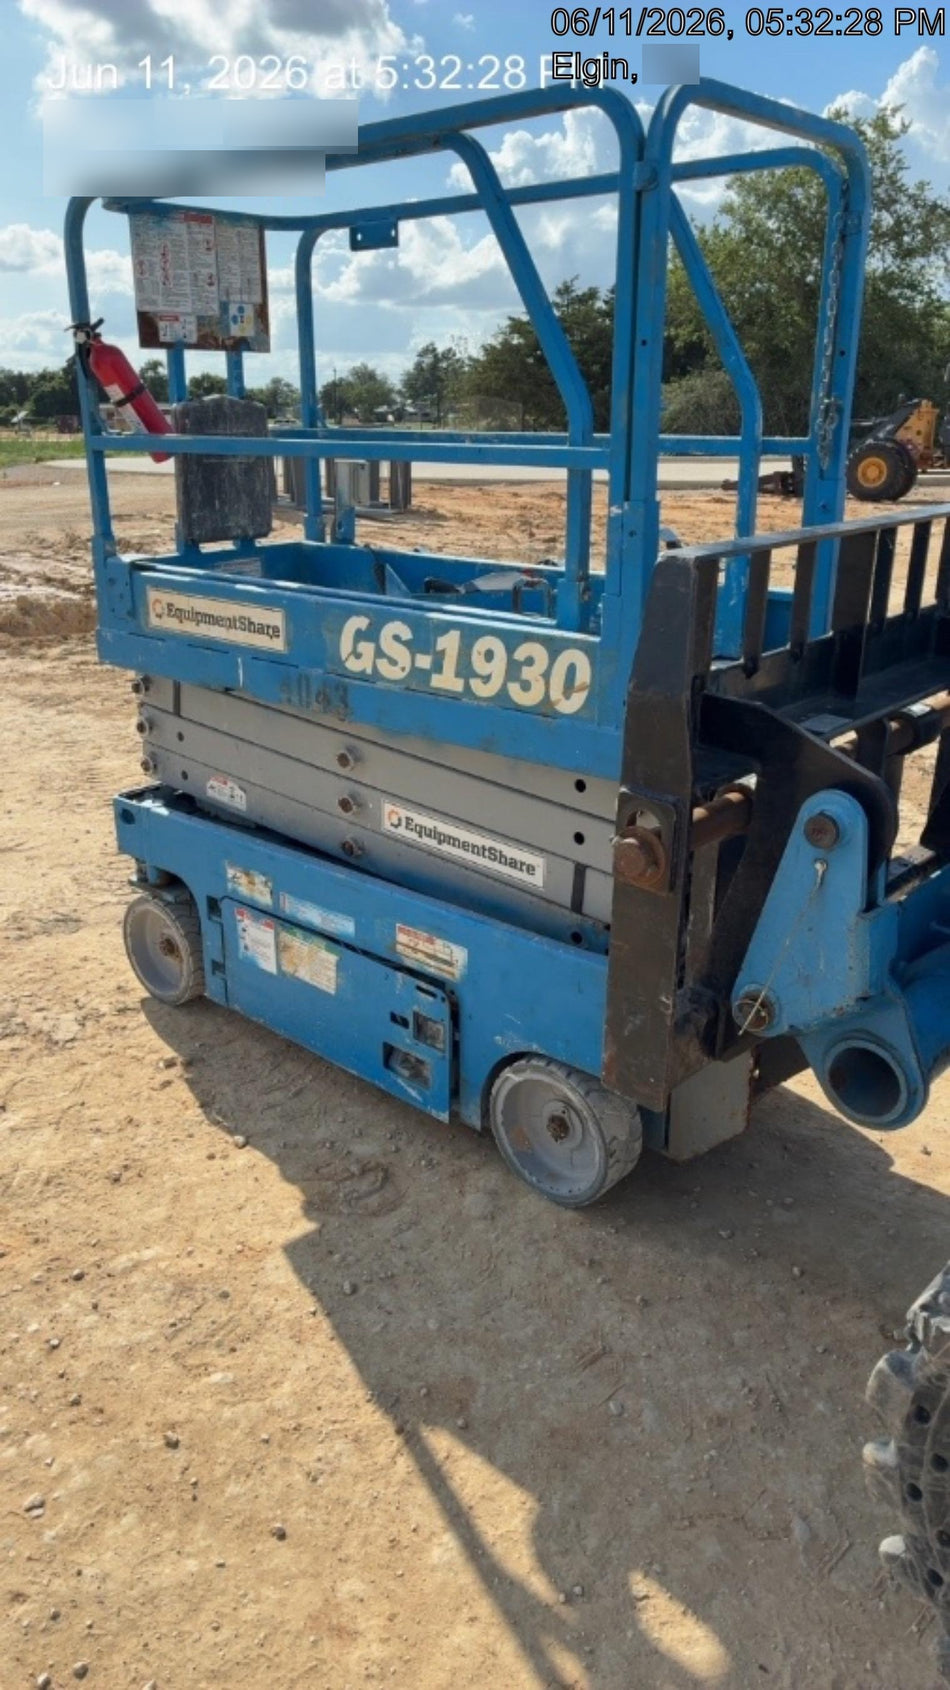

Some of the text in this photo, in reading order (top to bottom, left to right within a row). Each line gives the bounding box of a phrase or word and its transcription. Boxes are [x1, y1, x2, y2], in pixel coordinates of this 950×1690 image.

[166, 602, 281, 639] EquipmentShare
[338, 614, 593, 715] GS-1930
[404, 815, 537, 876] EquipmentShare
